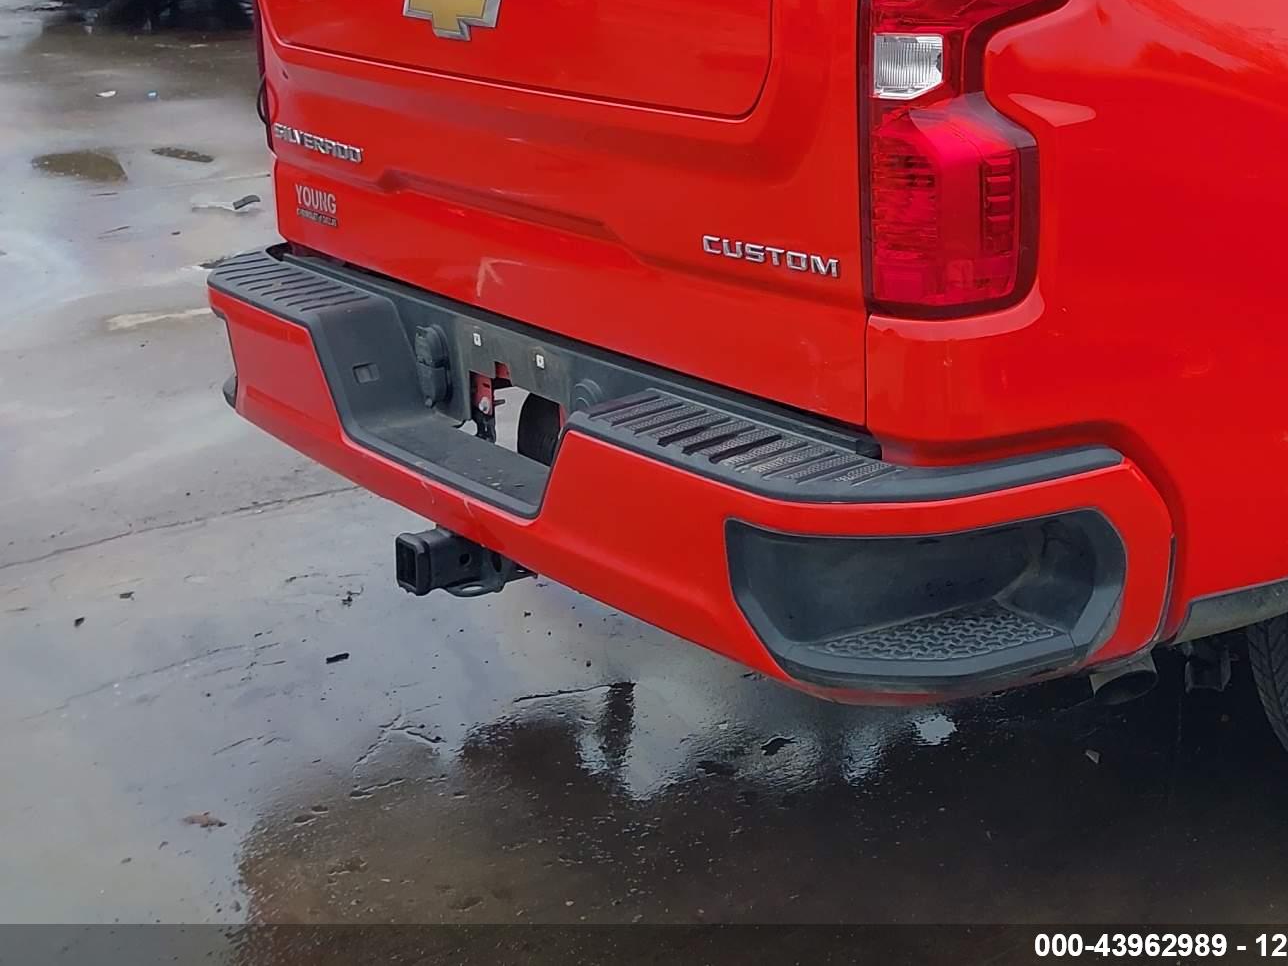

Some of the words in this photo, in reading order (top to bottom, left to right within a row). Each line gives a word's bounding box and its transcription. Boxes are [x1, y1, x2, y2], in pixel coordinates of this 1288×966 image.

[273, 122, 362, 163] SILVERADO
[295, 184, 337, 214] YOUNG
[703, 234, 840, 278] CUSTOM
